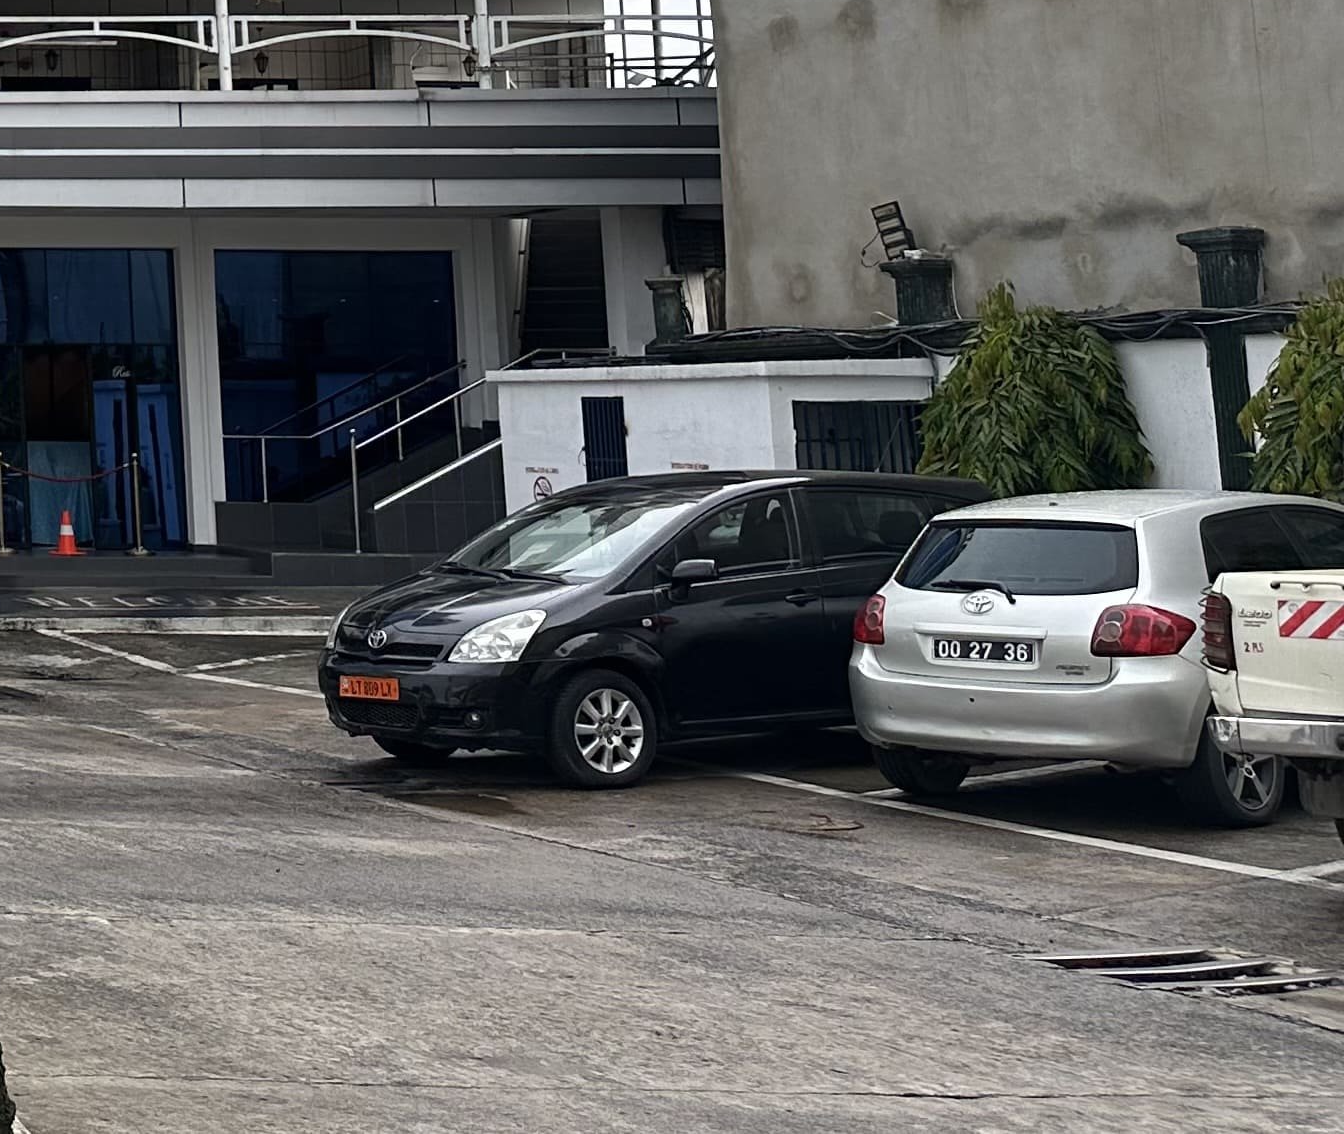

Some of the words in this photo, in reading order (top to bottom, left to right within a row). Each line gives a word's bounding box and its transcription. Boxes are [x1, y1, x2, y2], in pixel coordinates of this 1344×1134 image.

[938, 640, 960, 658] 00
[969, 641, 992, 659] 27
[1004, 643, 1028, 662] 36
[351, 680, 362, 695] LT
[380, 681, 392, 698] LX
